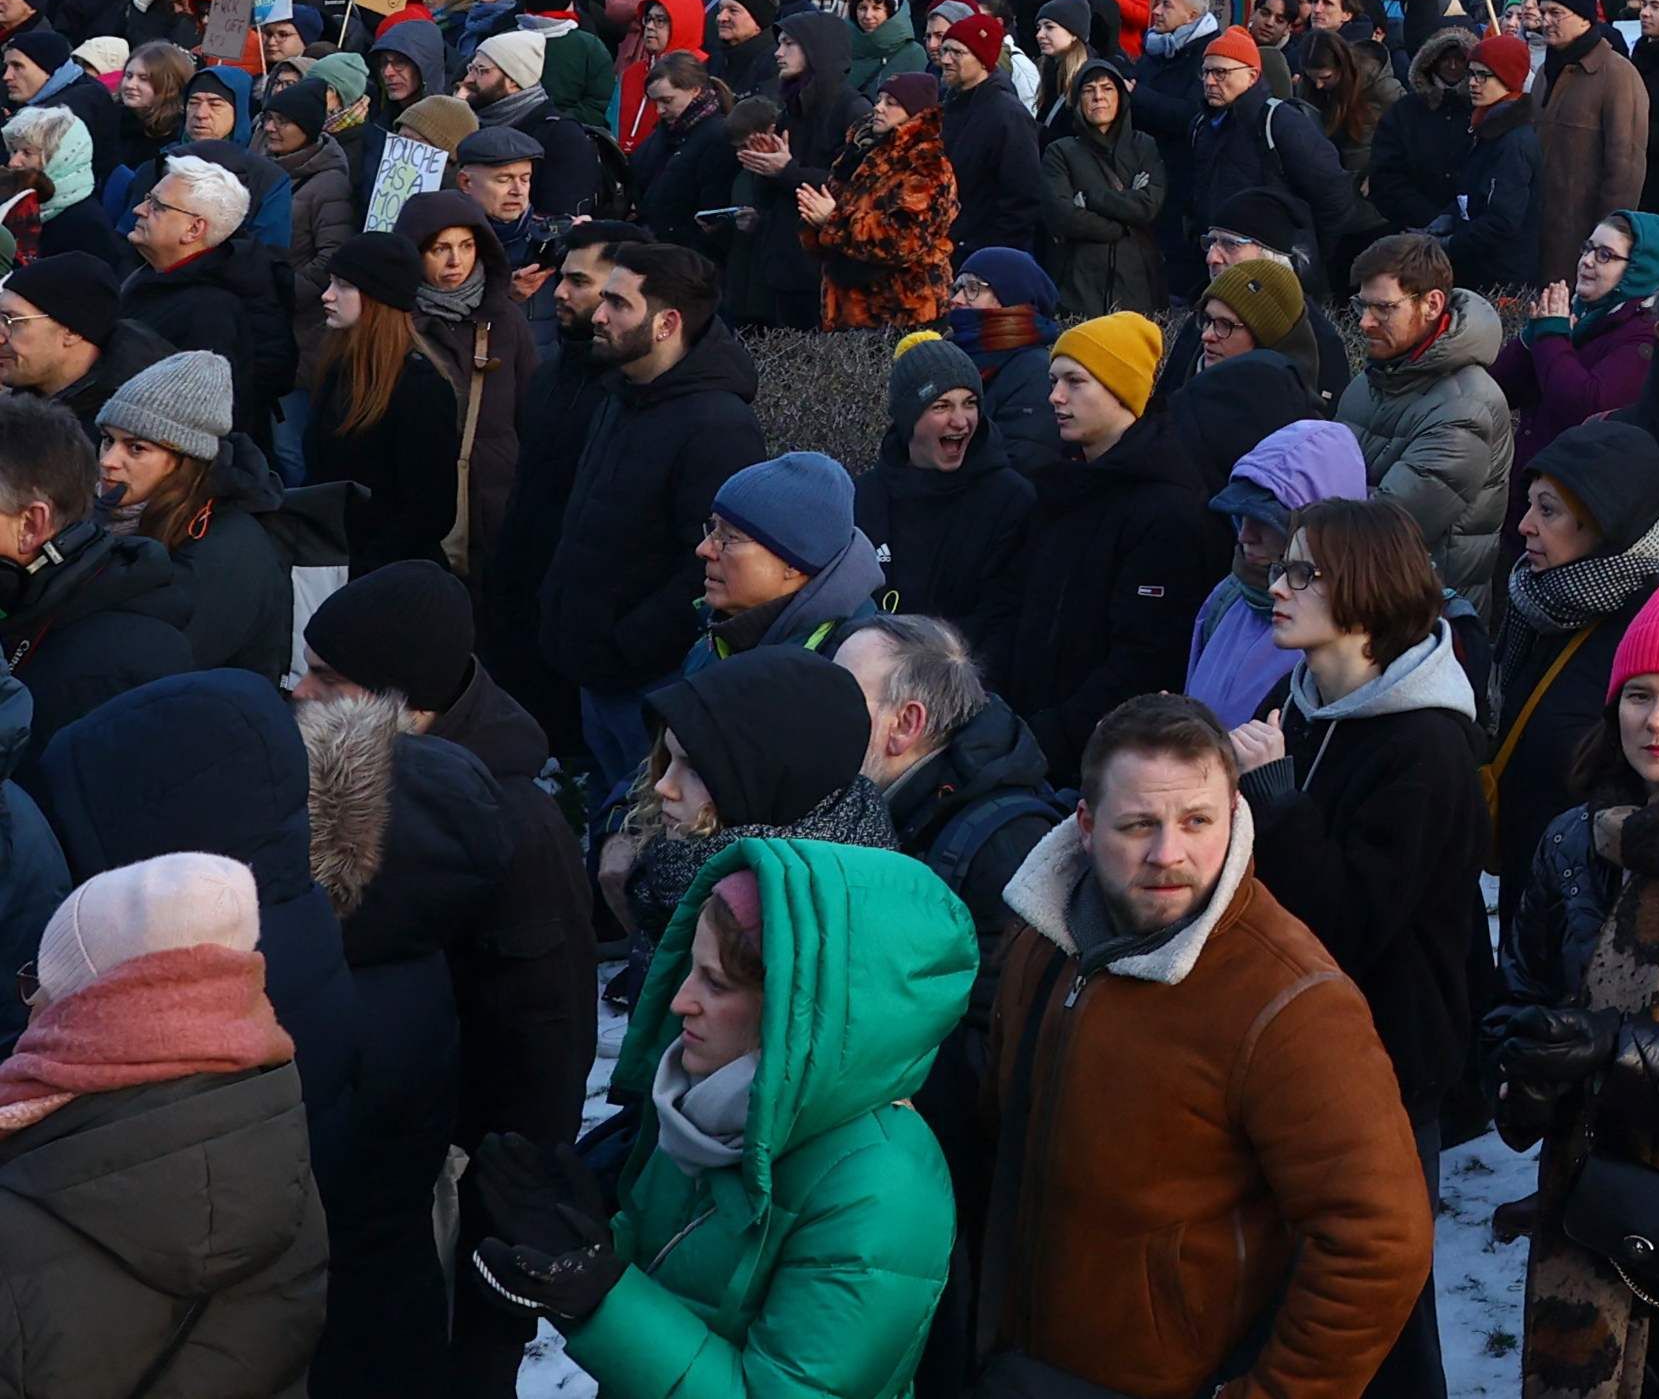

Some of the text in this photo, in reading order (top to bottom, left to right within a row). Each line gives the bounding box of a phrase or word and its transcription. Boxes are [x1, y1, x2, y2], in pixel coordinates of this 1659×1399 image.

[386, 136, 444, 174] TOUCHE
[377, 159, 408, 191] PAS
[371, 187, 407, 220] MO
